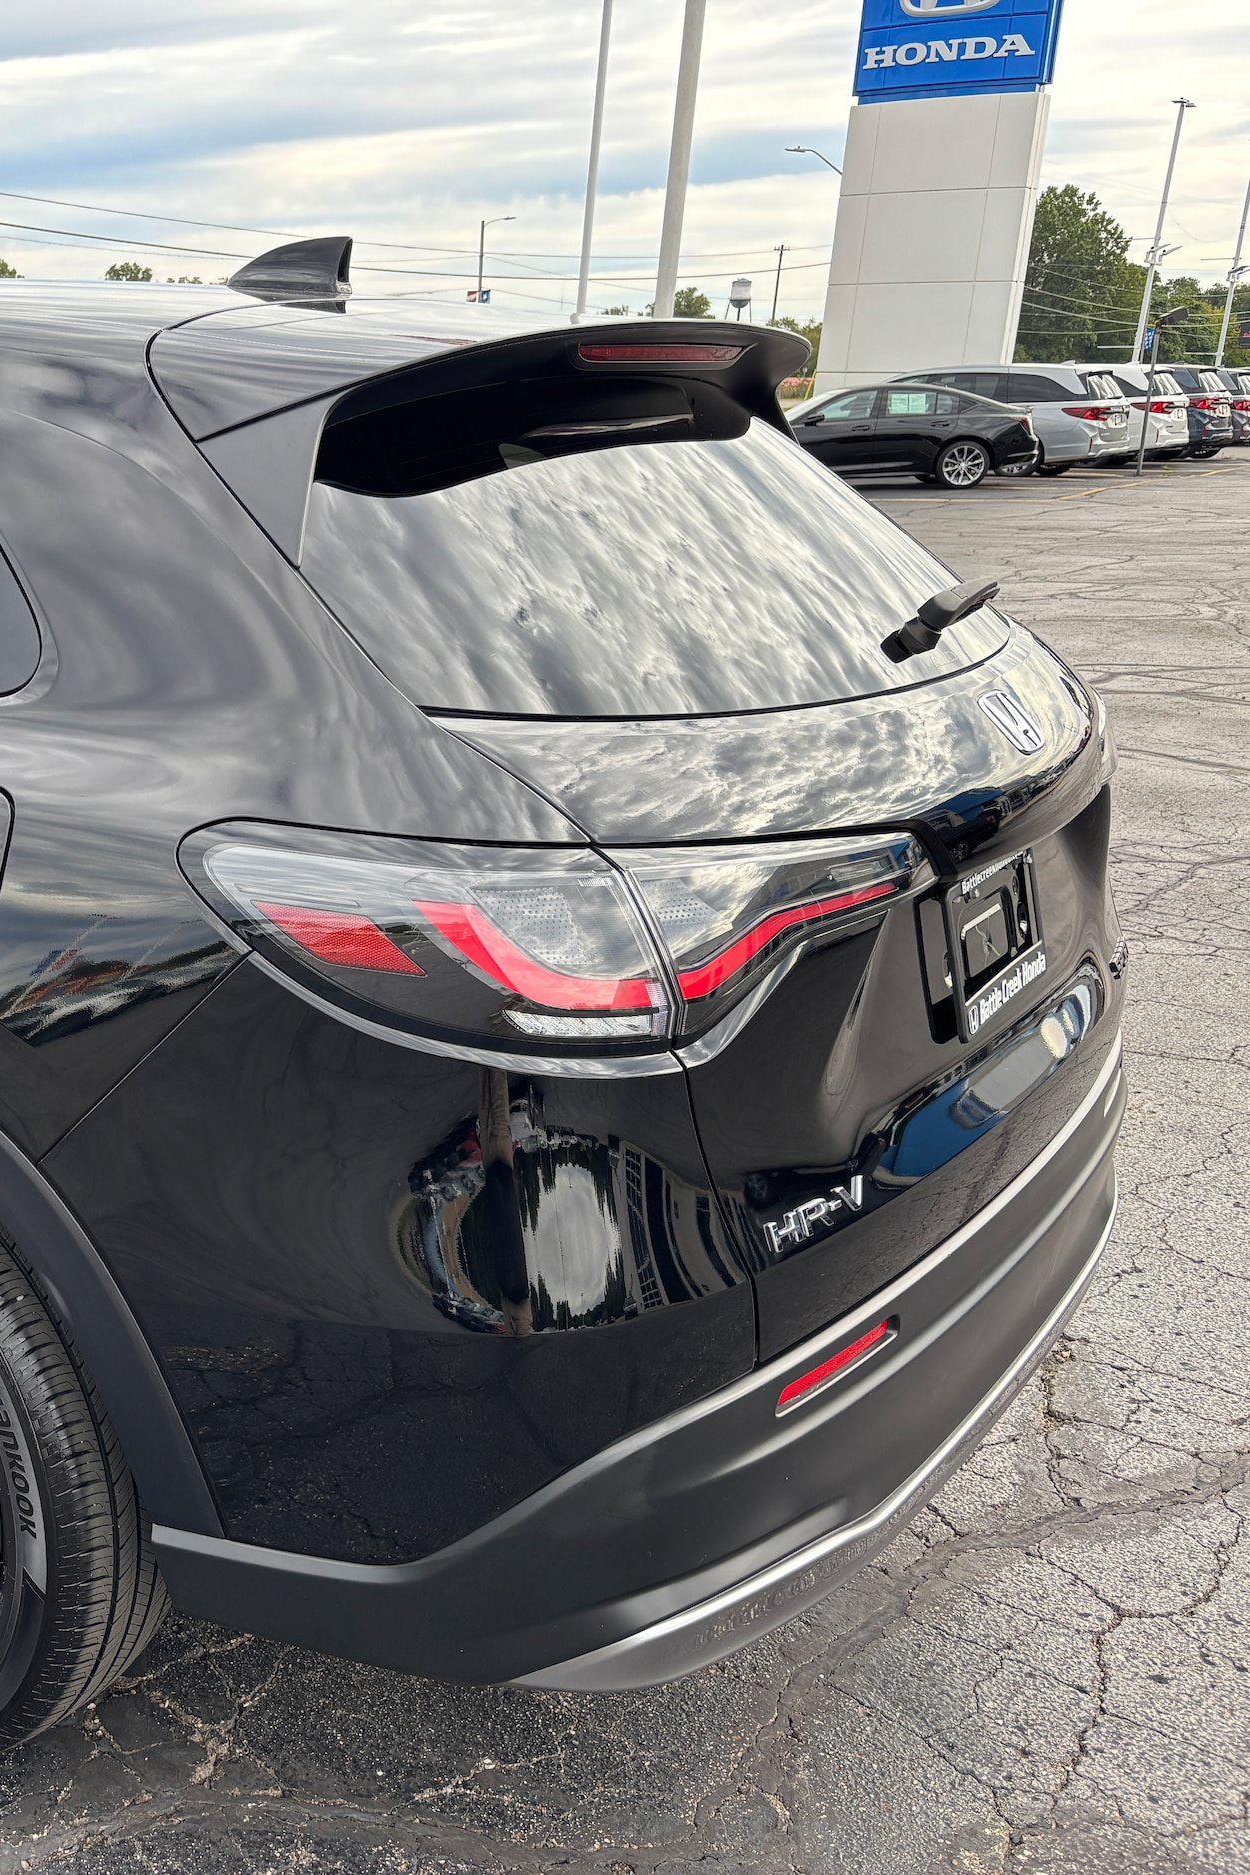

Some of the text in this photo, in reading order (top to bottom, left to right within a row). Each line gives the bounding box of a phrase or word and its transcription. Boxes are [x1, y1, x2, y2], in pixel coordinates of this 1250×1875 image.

[862, 33, 1036, 70] HONDA
[979, 951, 1046, 1025] Battle Creek Honda
[763, 1174, 864, 1253] HR-V
